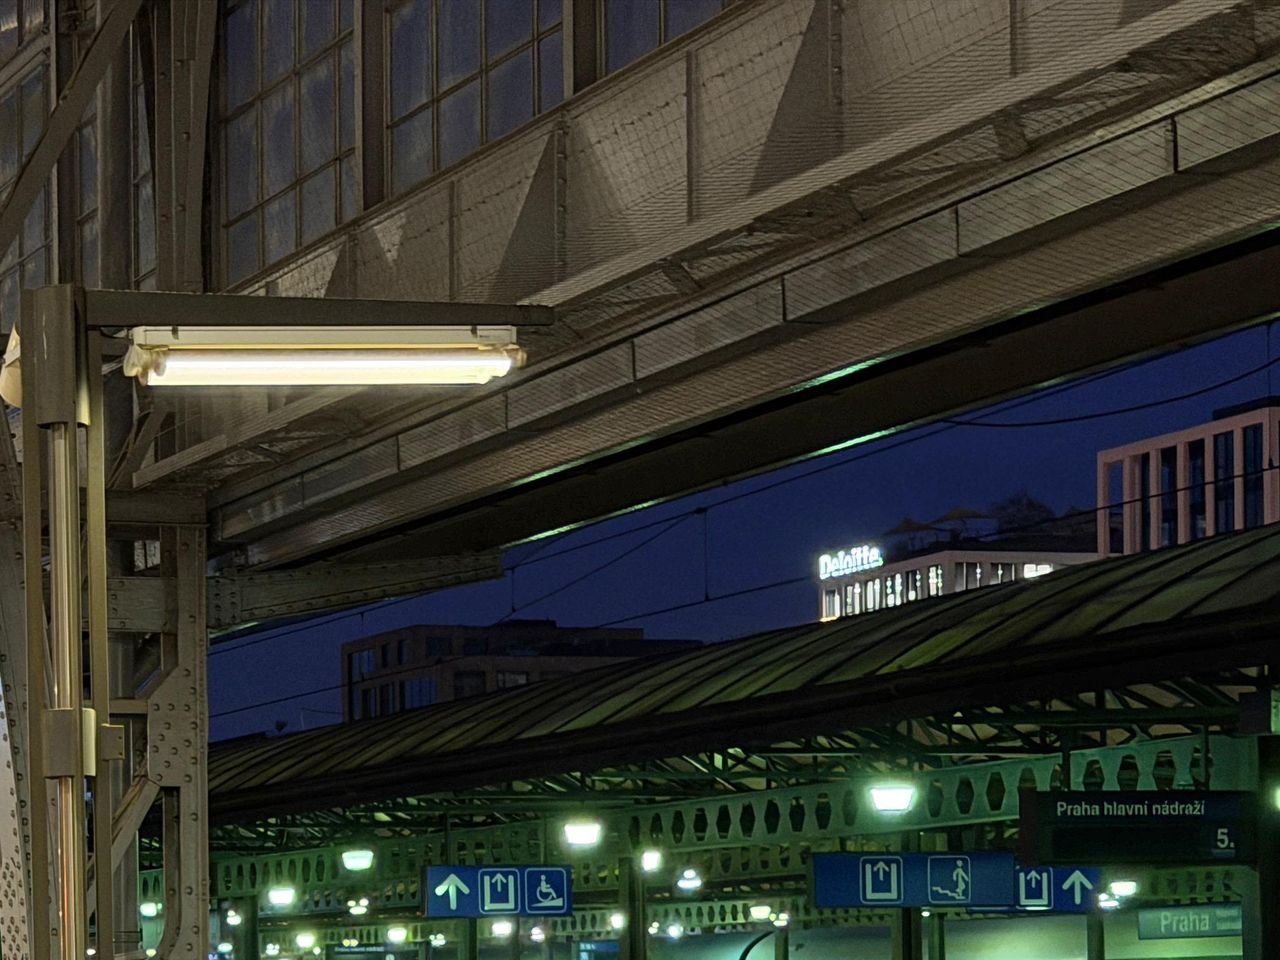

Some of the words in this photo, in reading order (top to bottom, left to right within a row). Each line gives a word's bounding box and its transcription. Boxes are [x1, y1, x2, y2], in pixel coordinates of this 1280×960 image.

[1056, 801, 1100, 817] Praha
[1104, 800, 1149, 816] hlavní
[1152, 799, 1206, 815] nádraží
[1216, 827, 1236, 849] 5.
[1160, 911, 1210, 934] Praha
